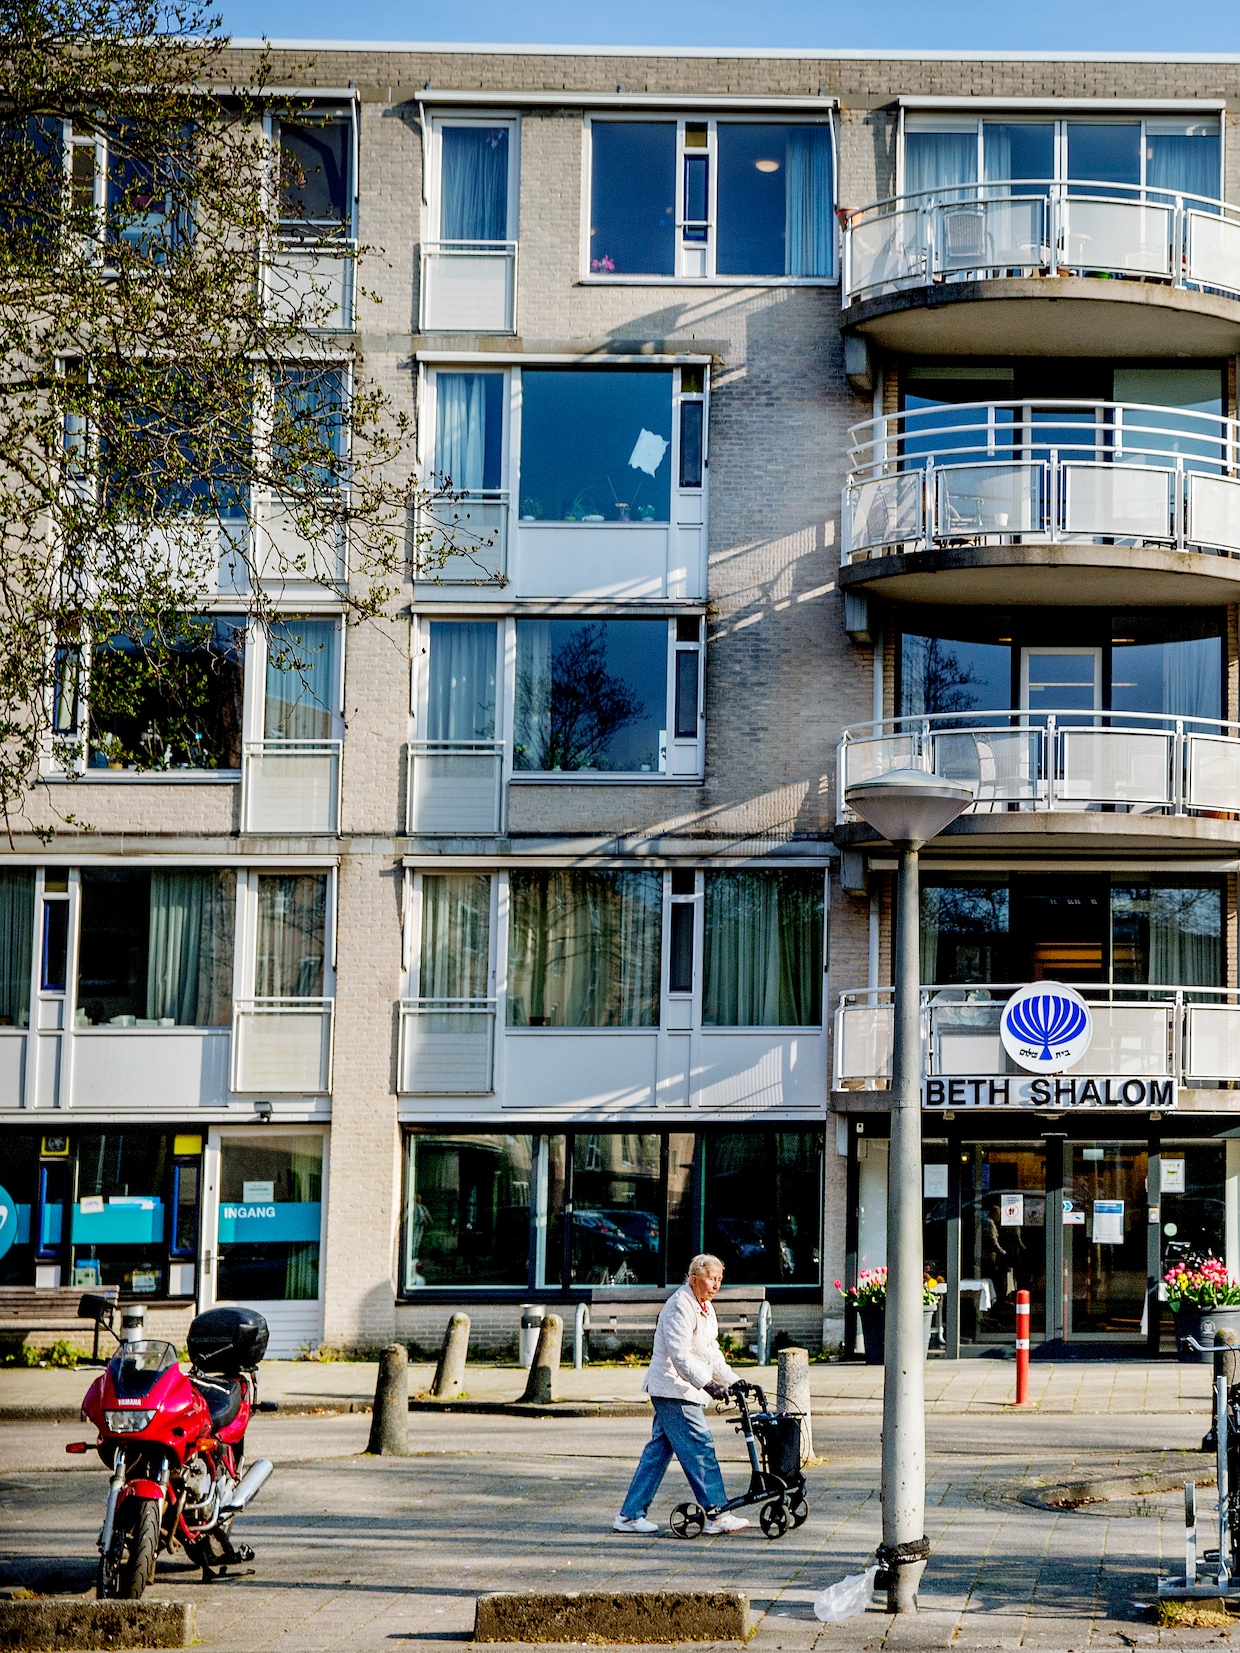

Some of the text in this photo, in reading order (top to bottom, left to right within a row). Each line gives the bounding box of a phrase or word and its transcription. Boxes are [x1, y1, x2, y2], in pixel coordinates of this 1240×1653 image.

[1055, 1049, 1071, 1059] בית
[926, 1078, 1174, 1106] BETH SHALOM
[223, 1206, 276, 1219] INGANG
[117, 1398, 142, 1406] YAMAHA
